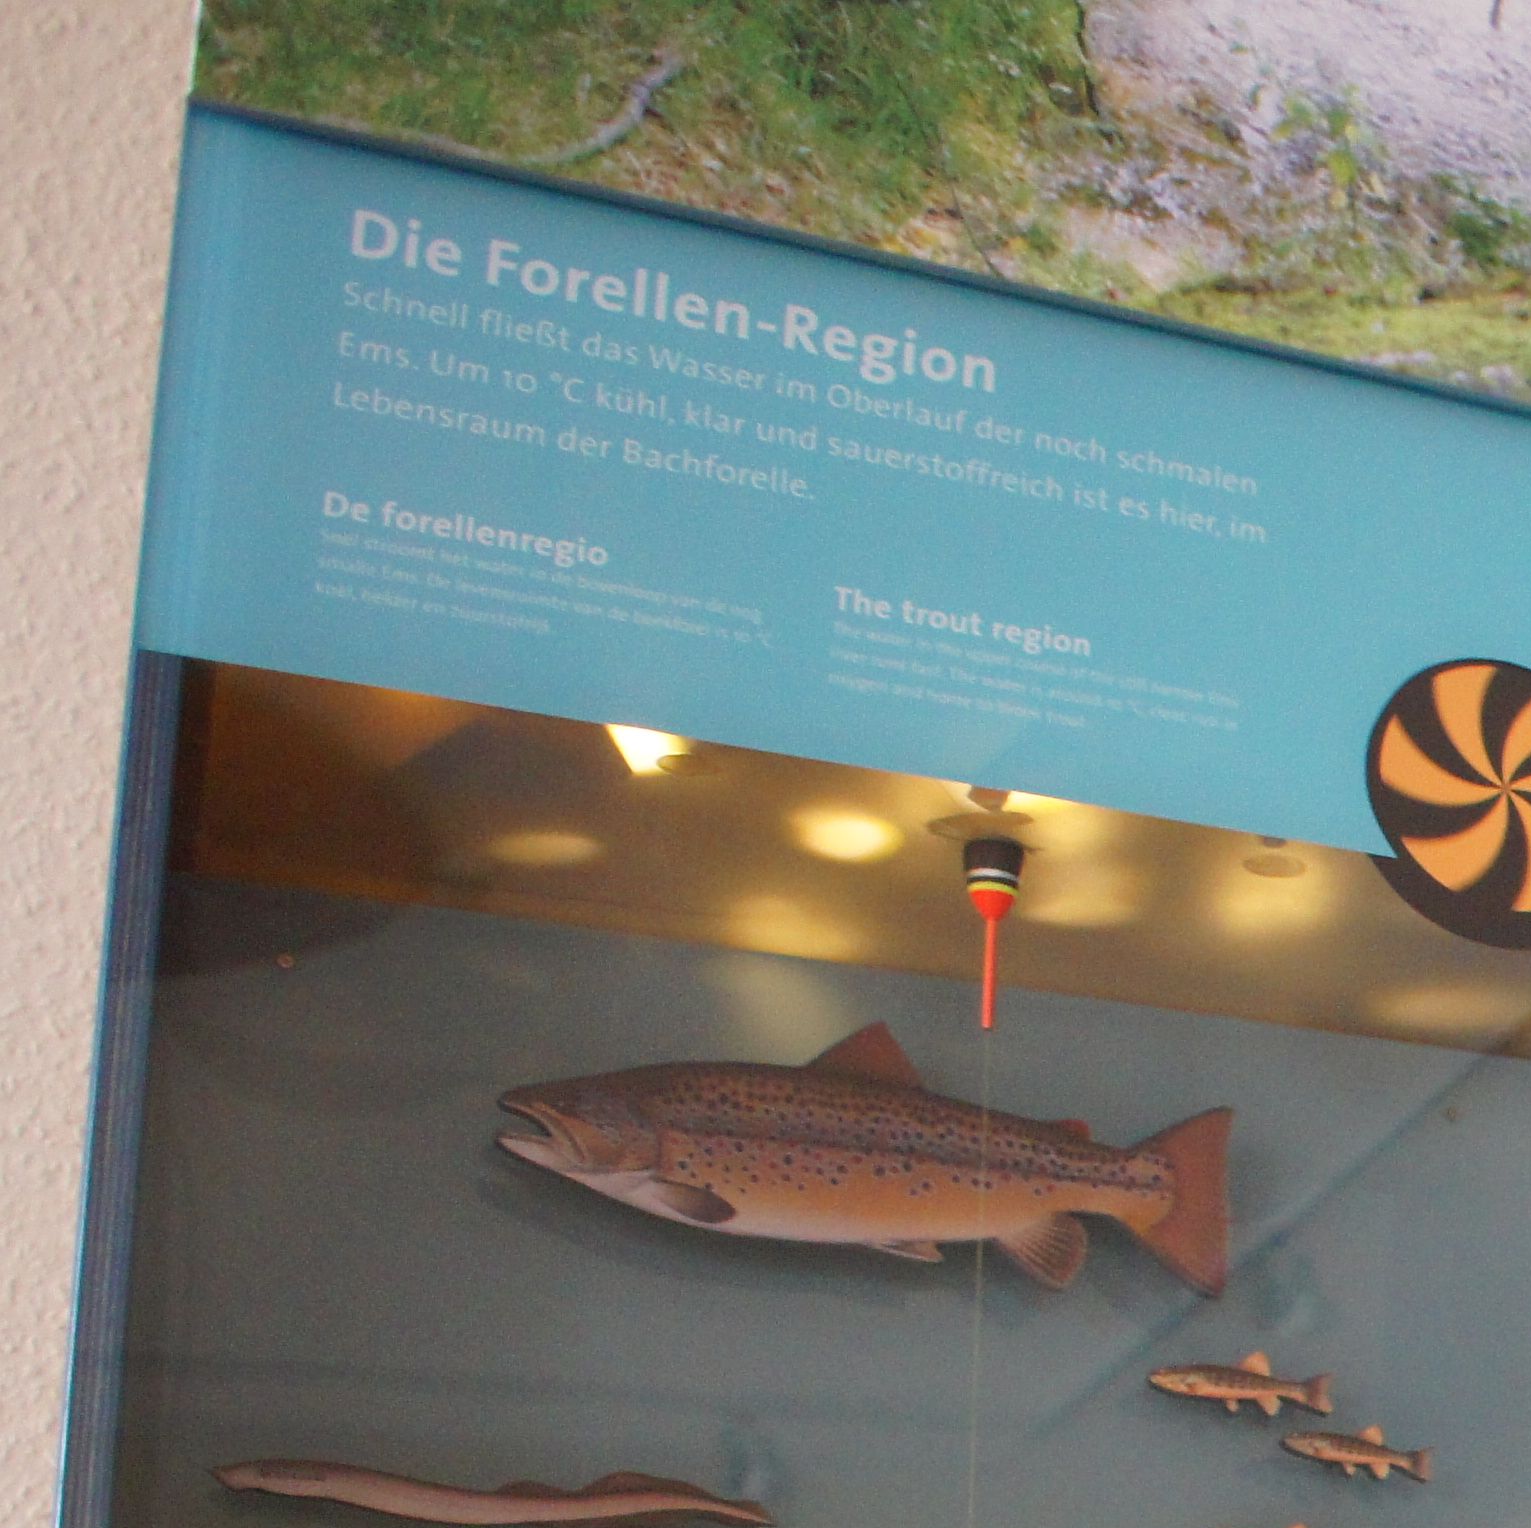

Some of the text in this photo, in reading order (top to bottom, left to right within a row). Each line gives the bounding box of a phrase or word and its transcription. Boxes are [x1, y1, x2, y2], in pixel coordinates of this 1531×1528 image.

[351, 208, 995, 392] Die Forellen-Region
[333, 381, 815, 501] Lebensraum der Bachforelle.
[337, 330, 418, 370] Ems.
[429, 349, 489, 384] Um
[595, 382, 674, 425] kühl,
[684, 400, 745, 435] klar
[756, 422, 818, 451] und
[828, 436, 1063, 501] sauerstoffreich
[1074, 484, 1108, 512] ist
[1118, 497, 1150, 520] es
[1160, 499, 1221, 538] hier,
[1230, 516, 1266, 544] im
[343, 280, 1258, 496] Schnell fließt das Wasser im Oberlauf der noch schmalen
[323, 490, 608, 568] De forellenregio
[834, 585, 1091, 656] The trout region
